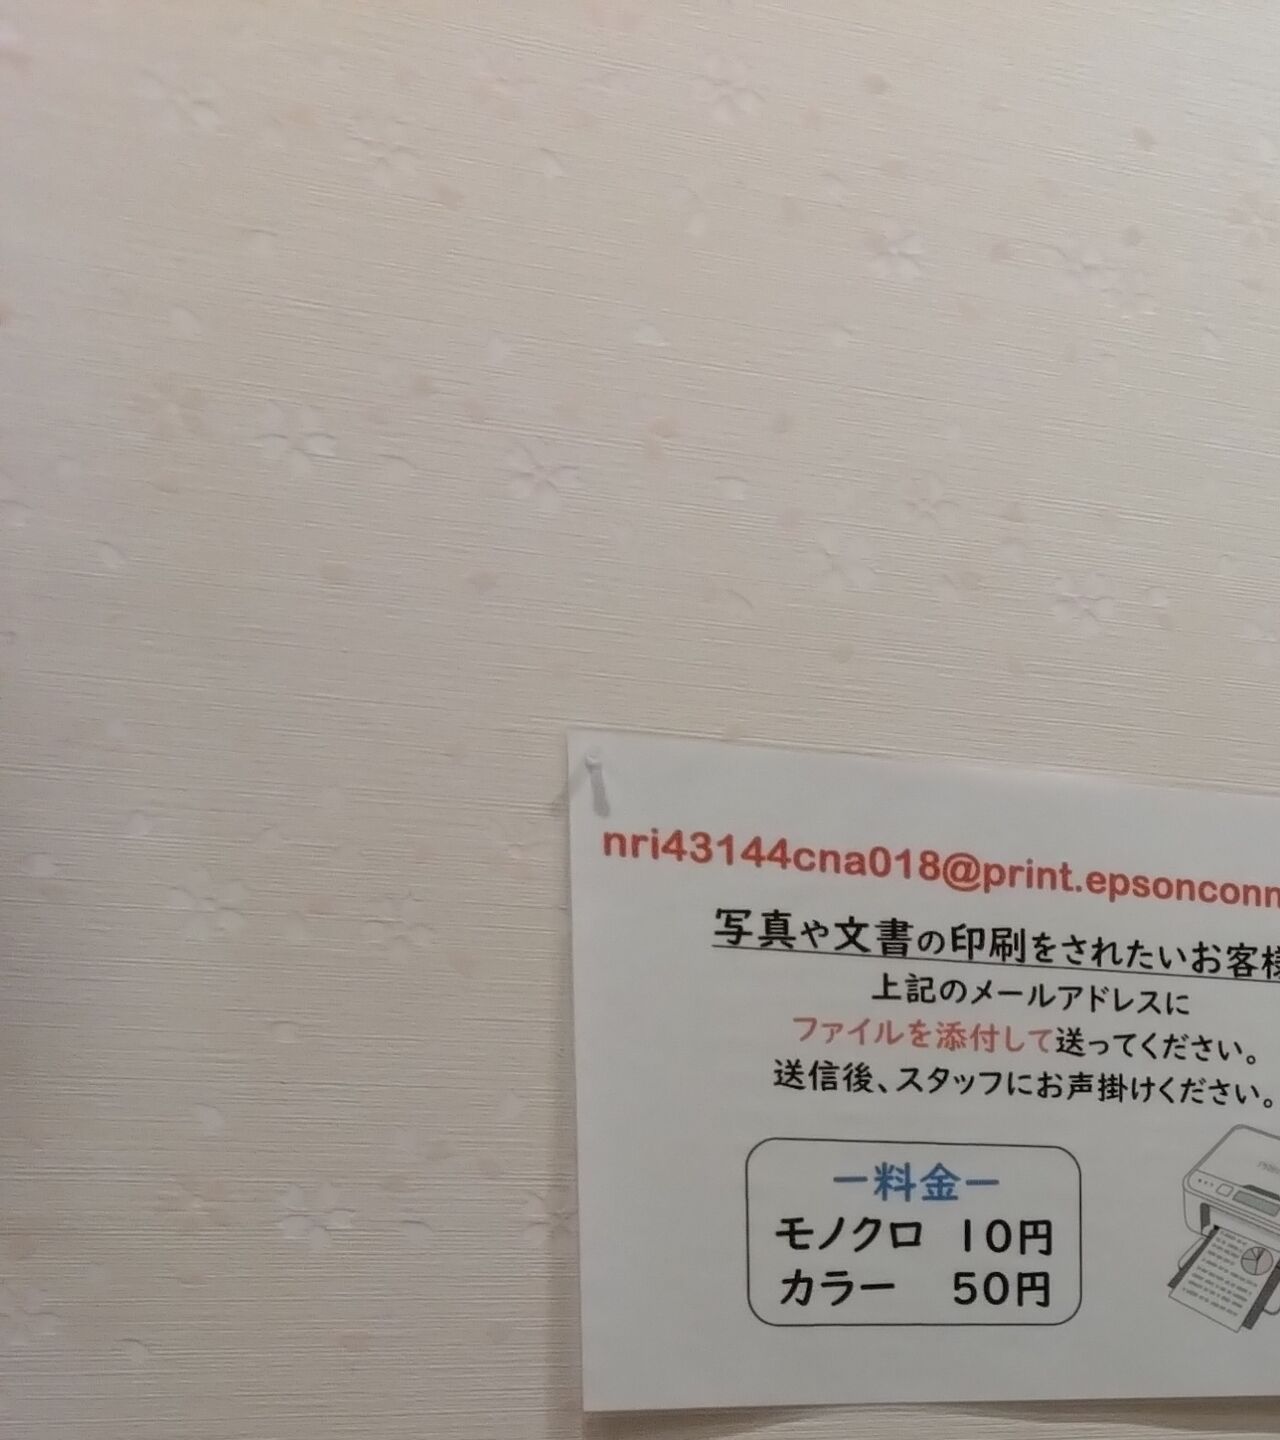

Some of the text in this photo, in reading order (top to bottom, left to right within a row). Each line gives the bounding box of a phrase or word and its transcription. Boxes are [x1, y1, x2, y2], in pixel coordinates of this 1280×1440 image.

[872, 972, 1191, 1016] 上記のメールアドレスに
[792, 1013, 1260, 1065] ファイルを添付して送ってください。
[773, 1058, 1275, 1109] 送信後、スタッフにお声掛けください。
[774, 1216, 1053, 1257] モノクロ 10円
[779, 1267, 1051, 1309] カラー 50円
